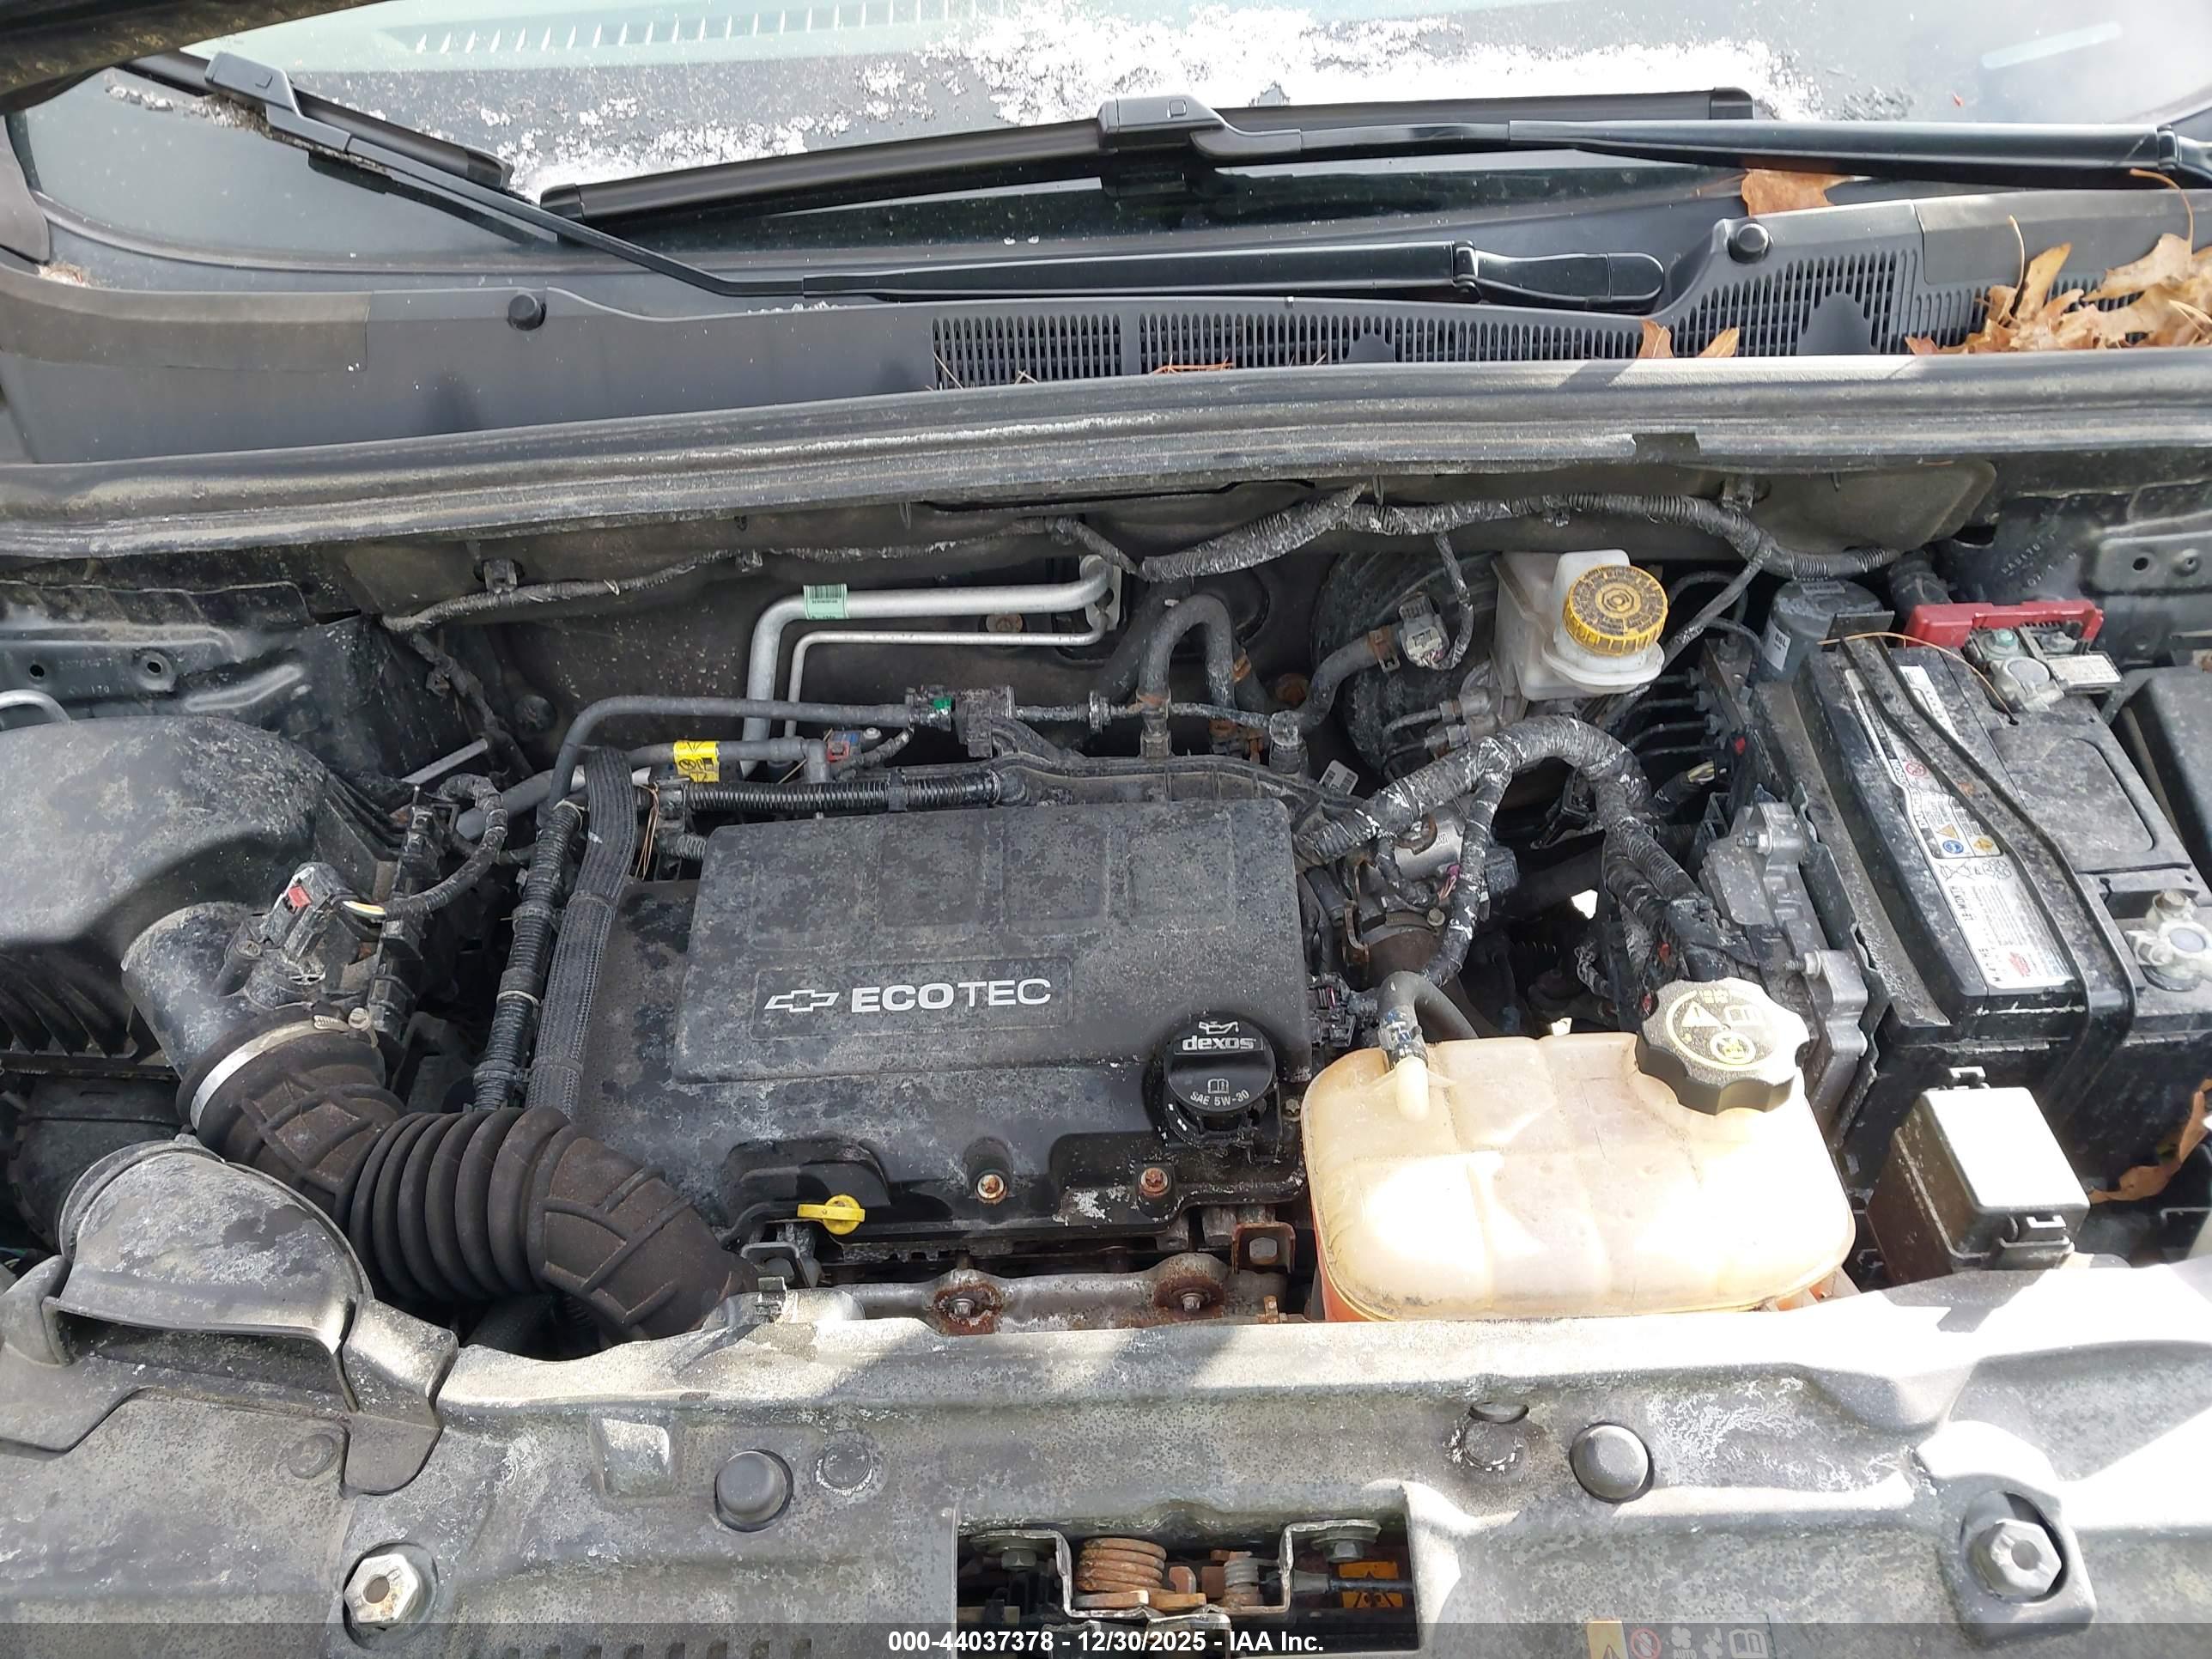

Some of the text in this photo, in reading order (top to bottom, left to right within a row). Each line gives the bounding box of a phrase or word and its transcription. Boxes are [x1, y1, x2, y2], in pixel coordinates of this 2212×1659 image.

[851, 978, 1052, 1013] ECOTEC
[1182, 1035, 1255, 1051] dexos
[1190, 1089, 1250, 1107] SAE 5W-30
